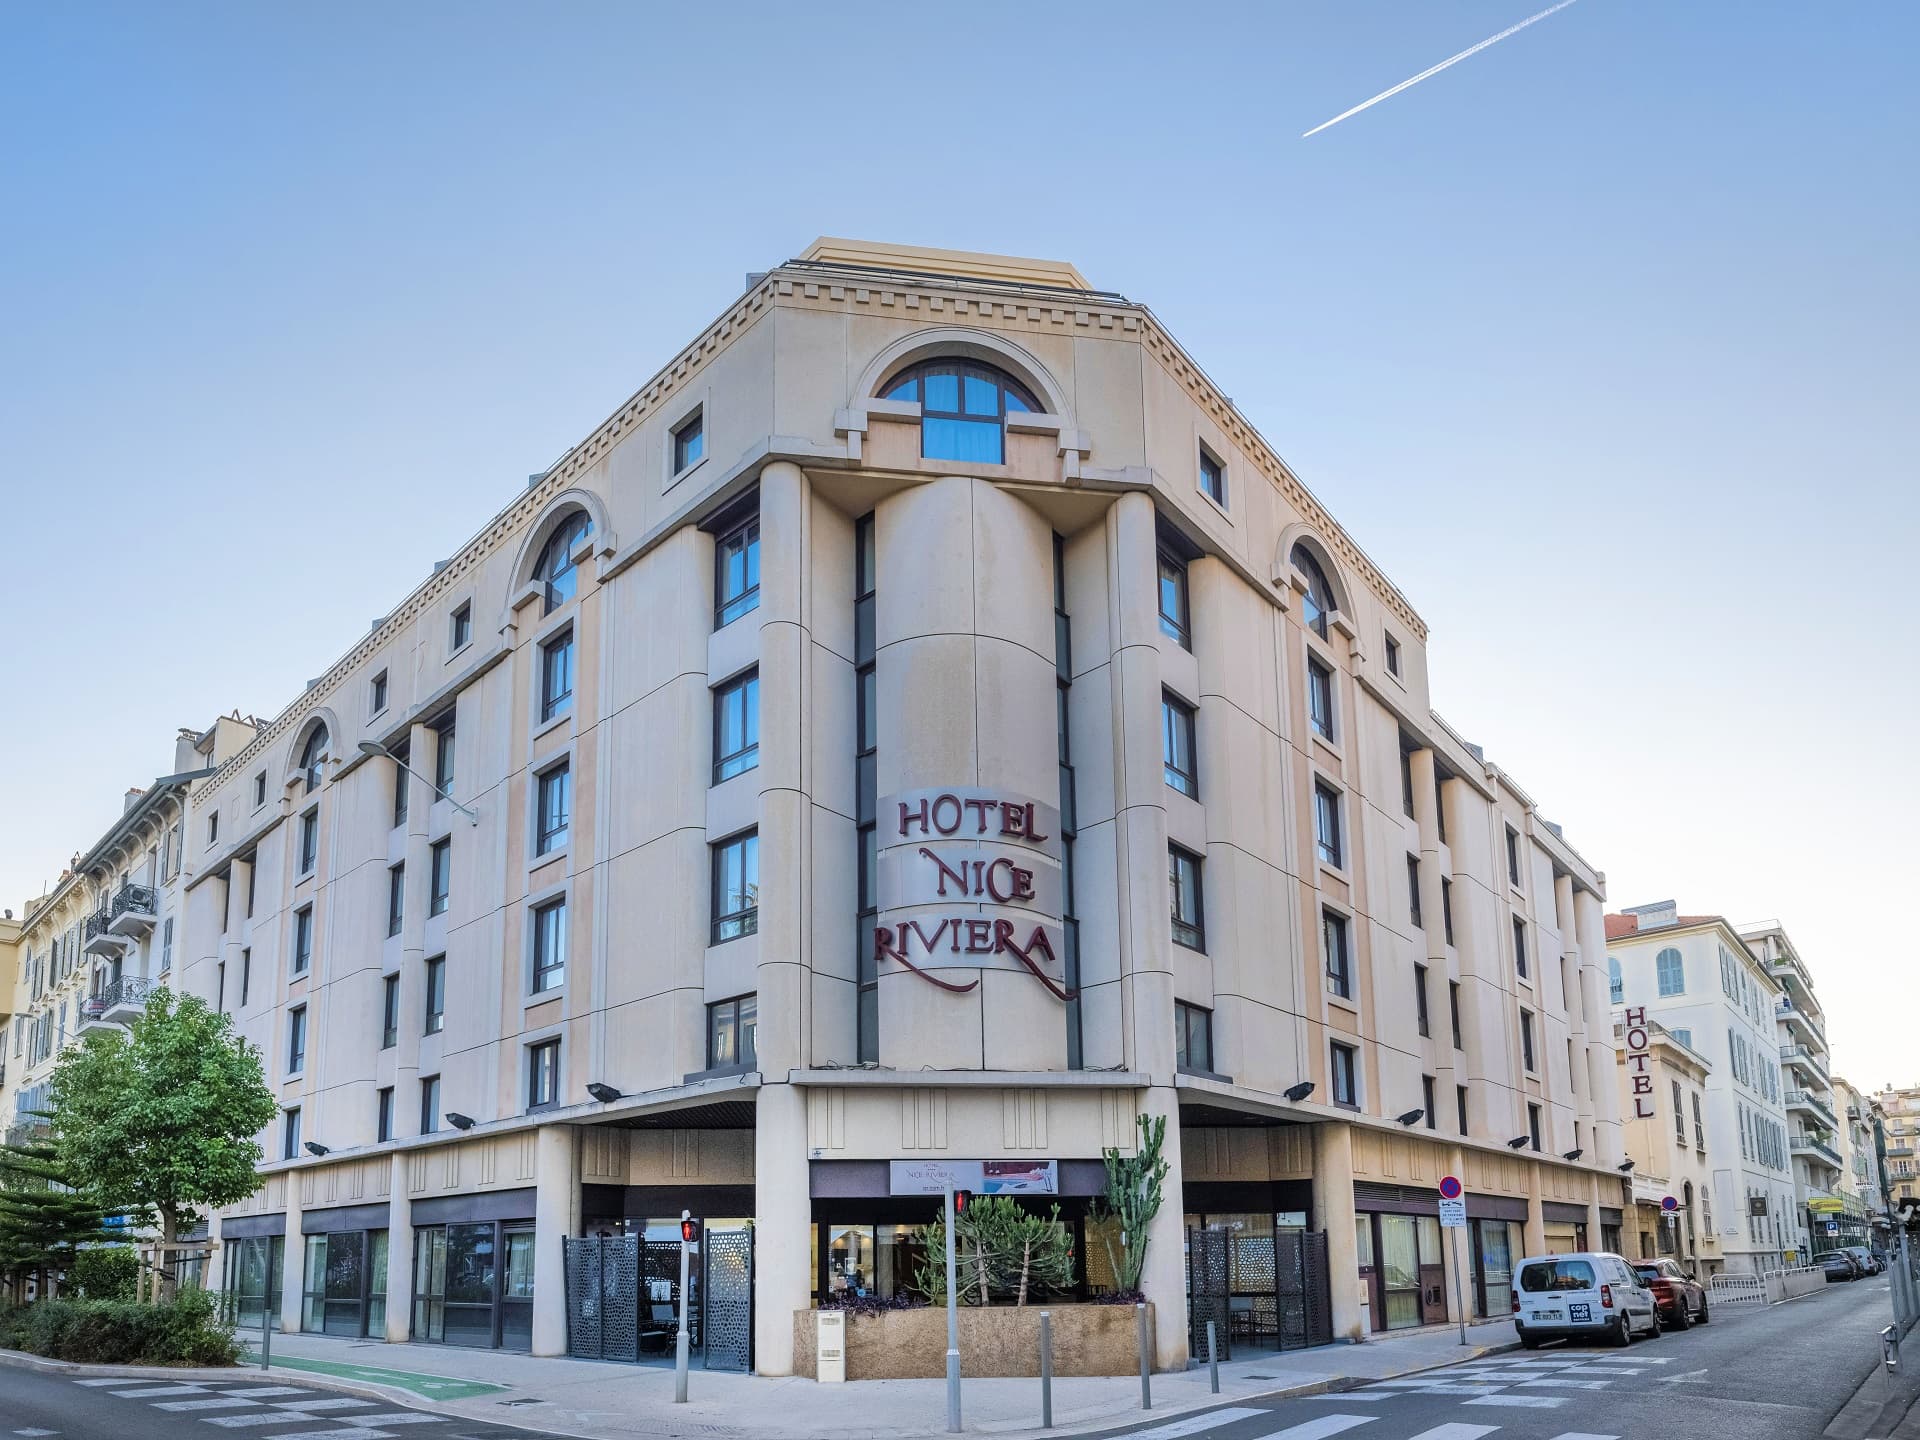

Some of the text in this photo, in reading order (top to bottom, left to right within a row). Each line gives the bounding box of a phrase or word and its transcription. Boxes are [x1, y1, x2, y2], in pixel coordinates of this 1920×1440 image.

[898, 793, 1048, 841] HOTEL
[919, 847, 1035, 902] NICE
[873, 918, 1081, 1001] RIVIERA
[1625, 1006, 1654, 1119] HOTEL
